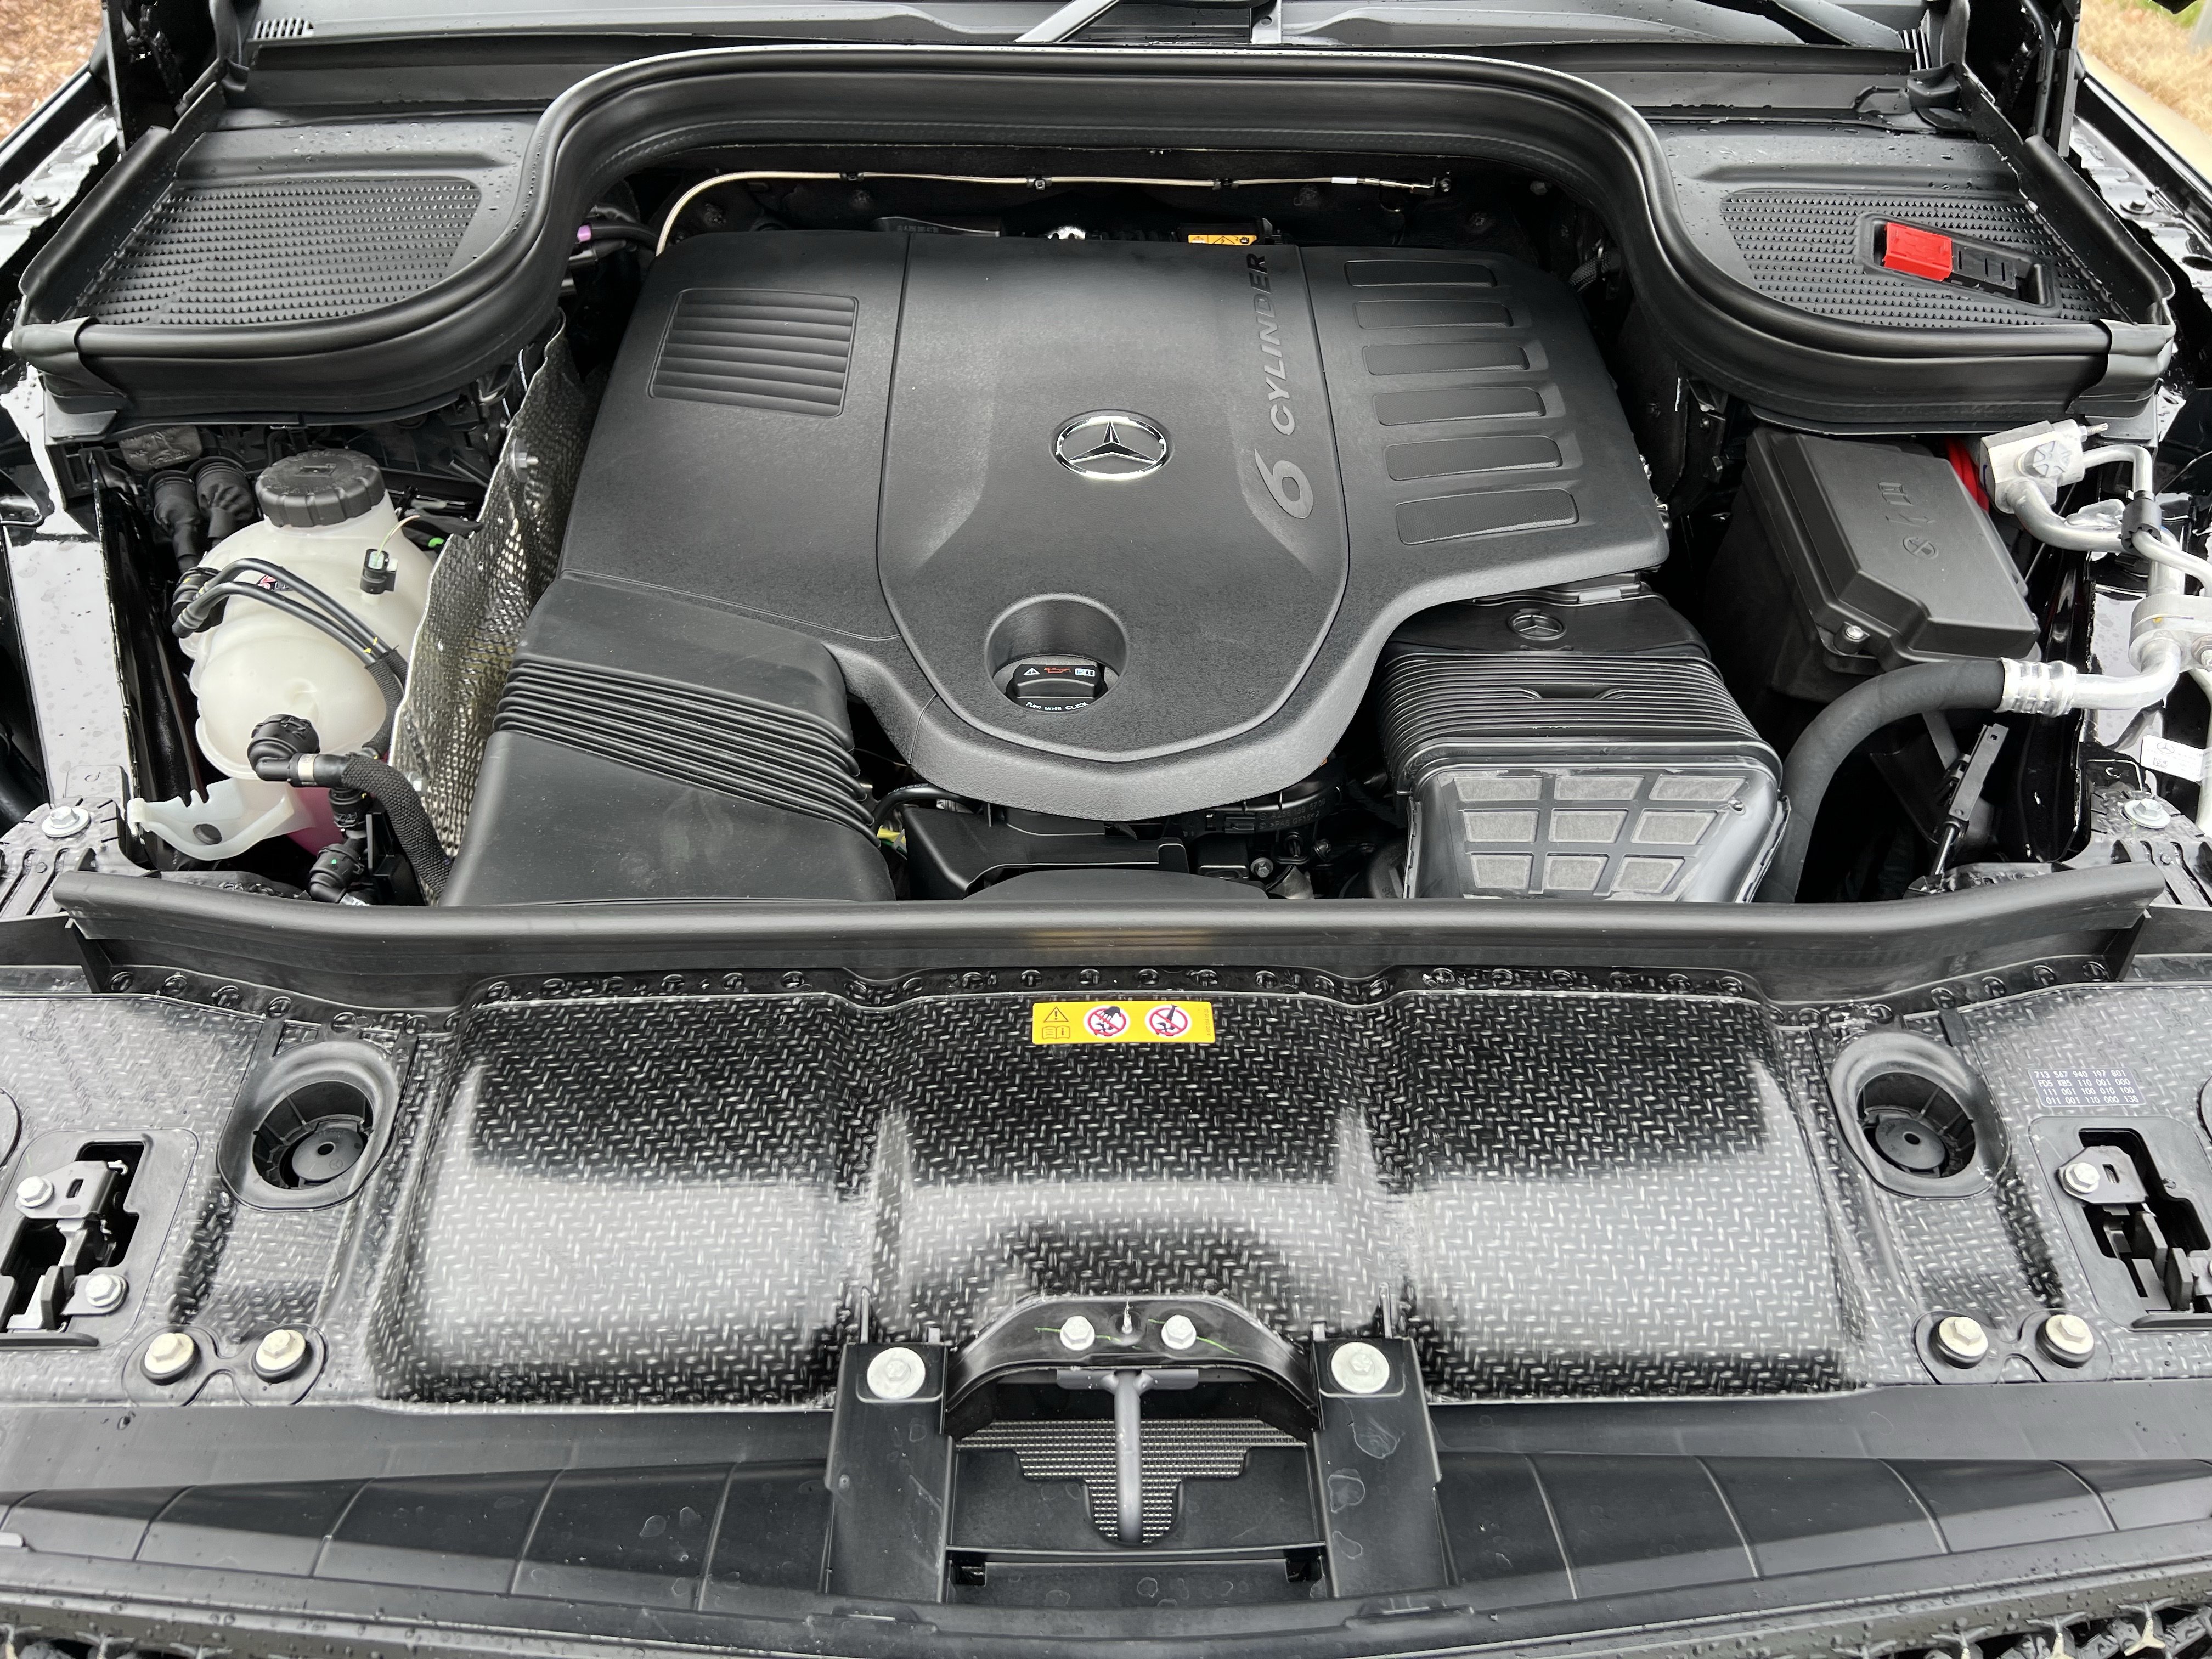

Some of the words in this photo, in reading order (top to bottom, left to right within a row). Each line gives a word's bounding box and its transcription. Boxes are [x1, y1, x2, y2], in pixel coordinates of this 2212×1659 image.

[1246, 252, 1296, 436] CYLINDER
[1254, 448, 1314, 520] 6
[1025, 701, 1042, 710] Turn
[1065, 701, 1089, 710] CLICK
[2038, 1079, 2053, 1087] FD5
[2123, 1095, 2139, 1103] 138
